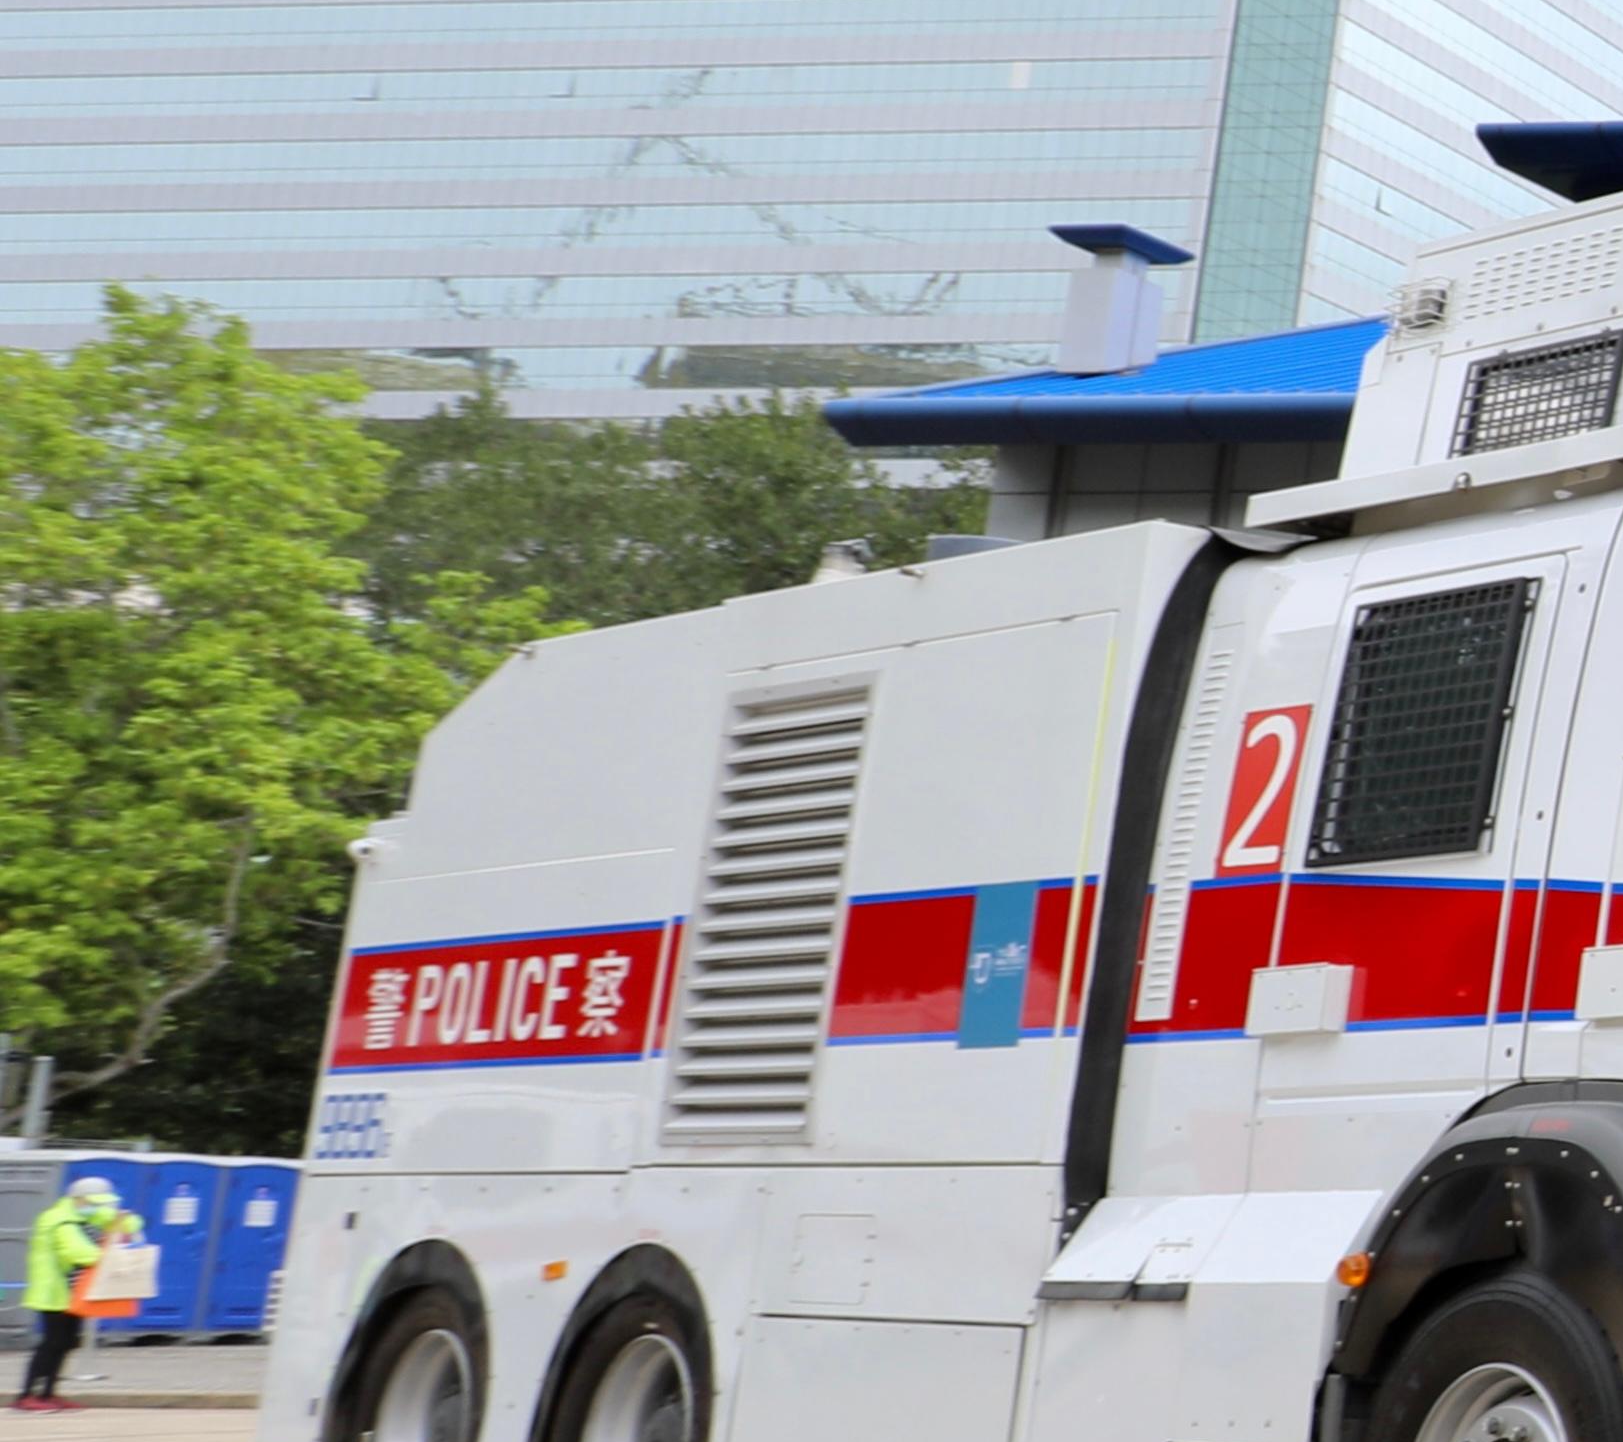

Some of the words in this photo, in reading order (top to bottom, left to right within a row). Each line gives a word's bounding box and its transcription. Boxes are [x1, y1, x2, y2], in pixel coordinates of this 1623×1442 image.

[1222, 714, 1297, 868] 2
[404, 953, 580, 1047] POLICE
[575, 950, 632, 1037] 察
